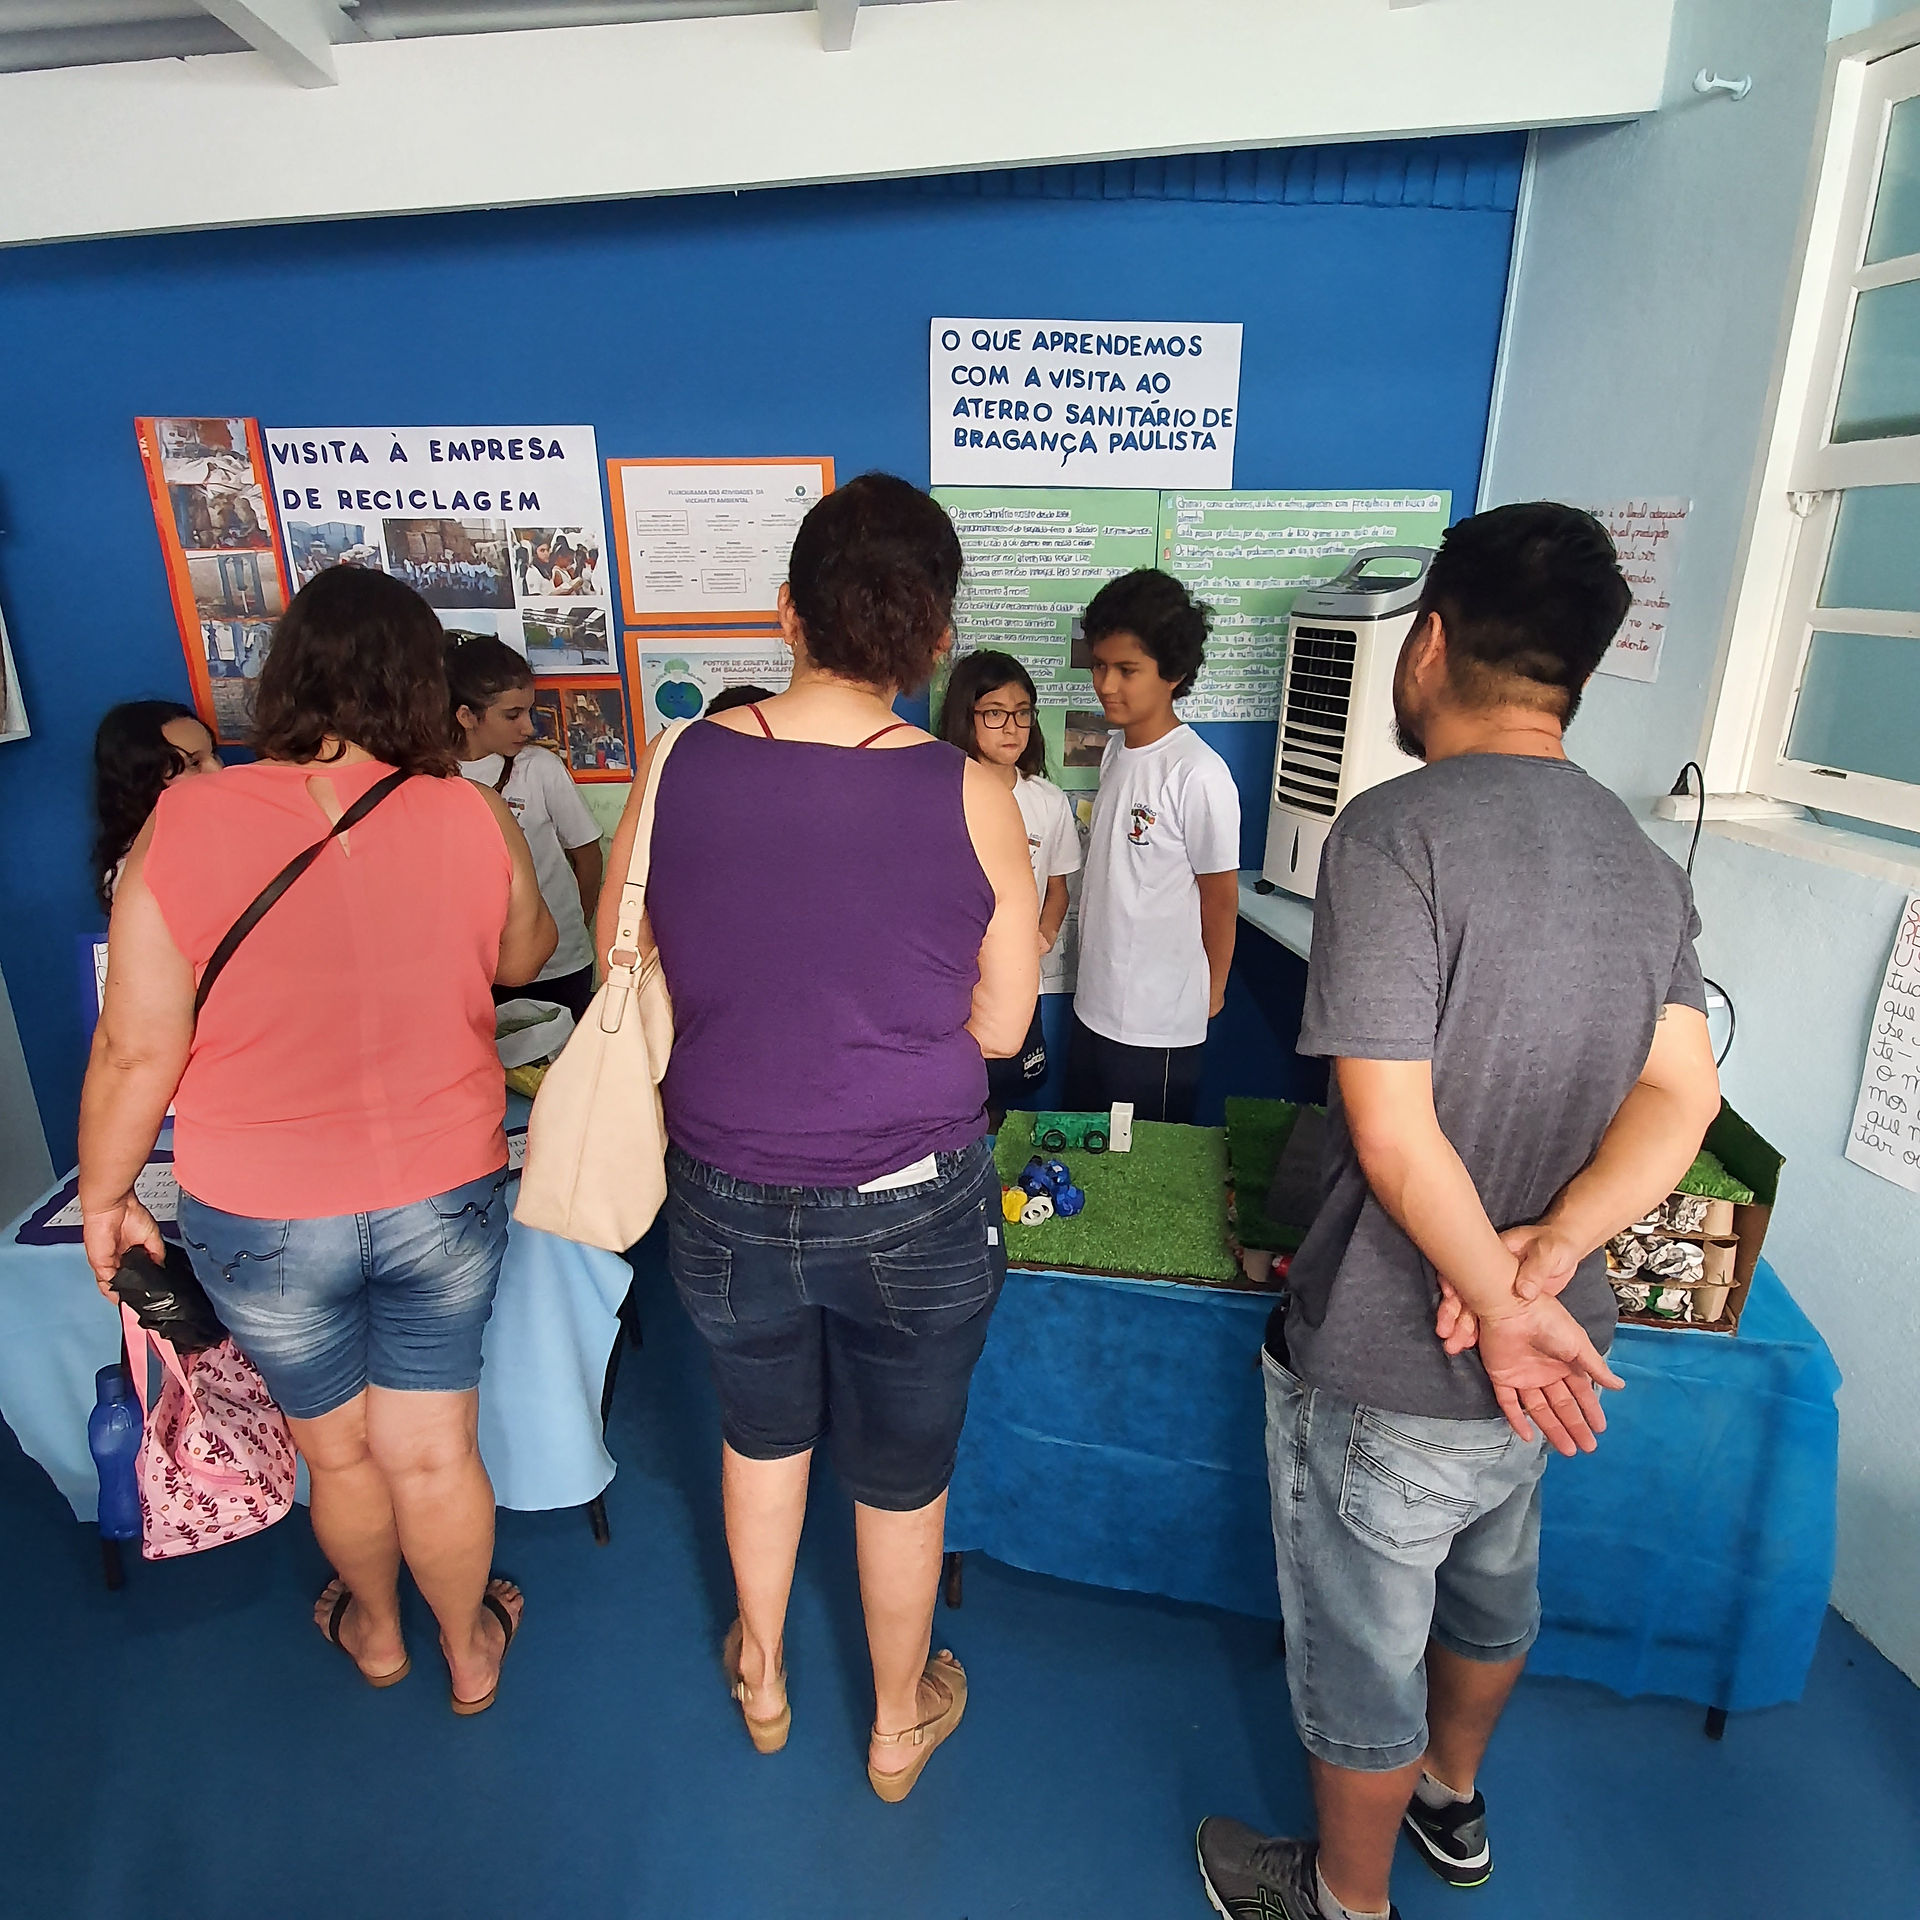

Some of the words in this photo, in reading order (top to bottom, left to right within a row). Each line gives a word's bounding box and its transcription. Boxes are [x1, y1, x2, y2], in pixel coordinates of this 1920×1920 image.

[942, 330, 960, 351] O
[971, 329, 1022, 351] QUE
[1032, 331, 1202, 357] APRENDEMOS
[951, 365, 1009, 386] COM
[1024, 366, 1041, 388] A
[1049, 368, 1126, 392] VISITA
[1136, 372, 1170, 394] AO
[953, 396, 1053, 422] ATERRO
[1065, 399, 1196, 428] SANITÁRIO
[1203, 407, 1233, 428] DE
[271, 440, 370, 465] VISITA
[389, 432, 408, 463] À
[429, 437, 565, 462] EMPRESA
[954, 427, 1098, 467] BRAGANÇA
[1110, 430, 1217, 453] PAULISTA
[283, 488, 322, 510] DE
[337, 489, 541, 511] RECICLAGEM
[1884, 1001, 1915, 1022] que
[1868, 1085, 1907, 1114] mos
[1867, 1111, 1899, 1136] que
